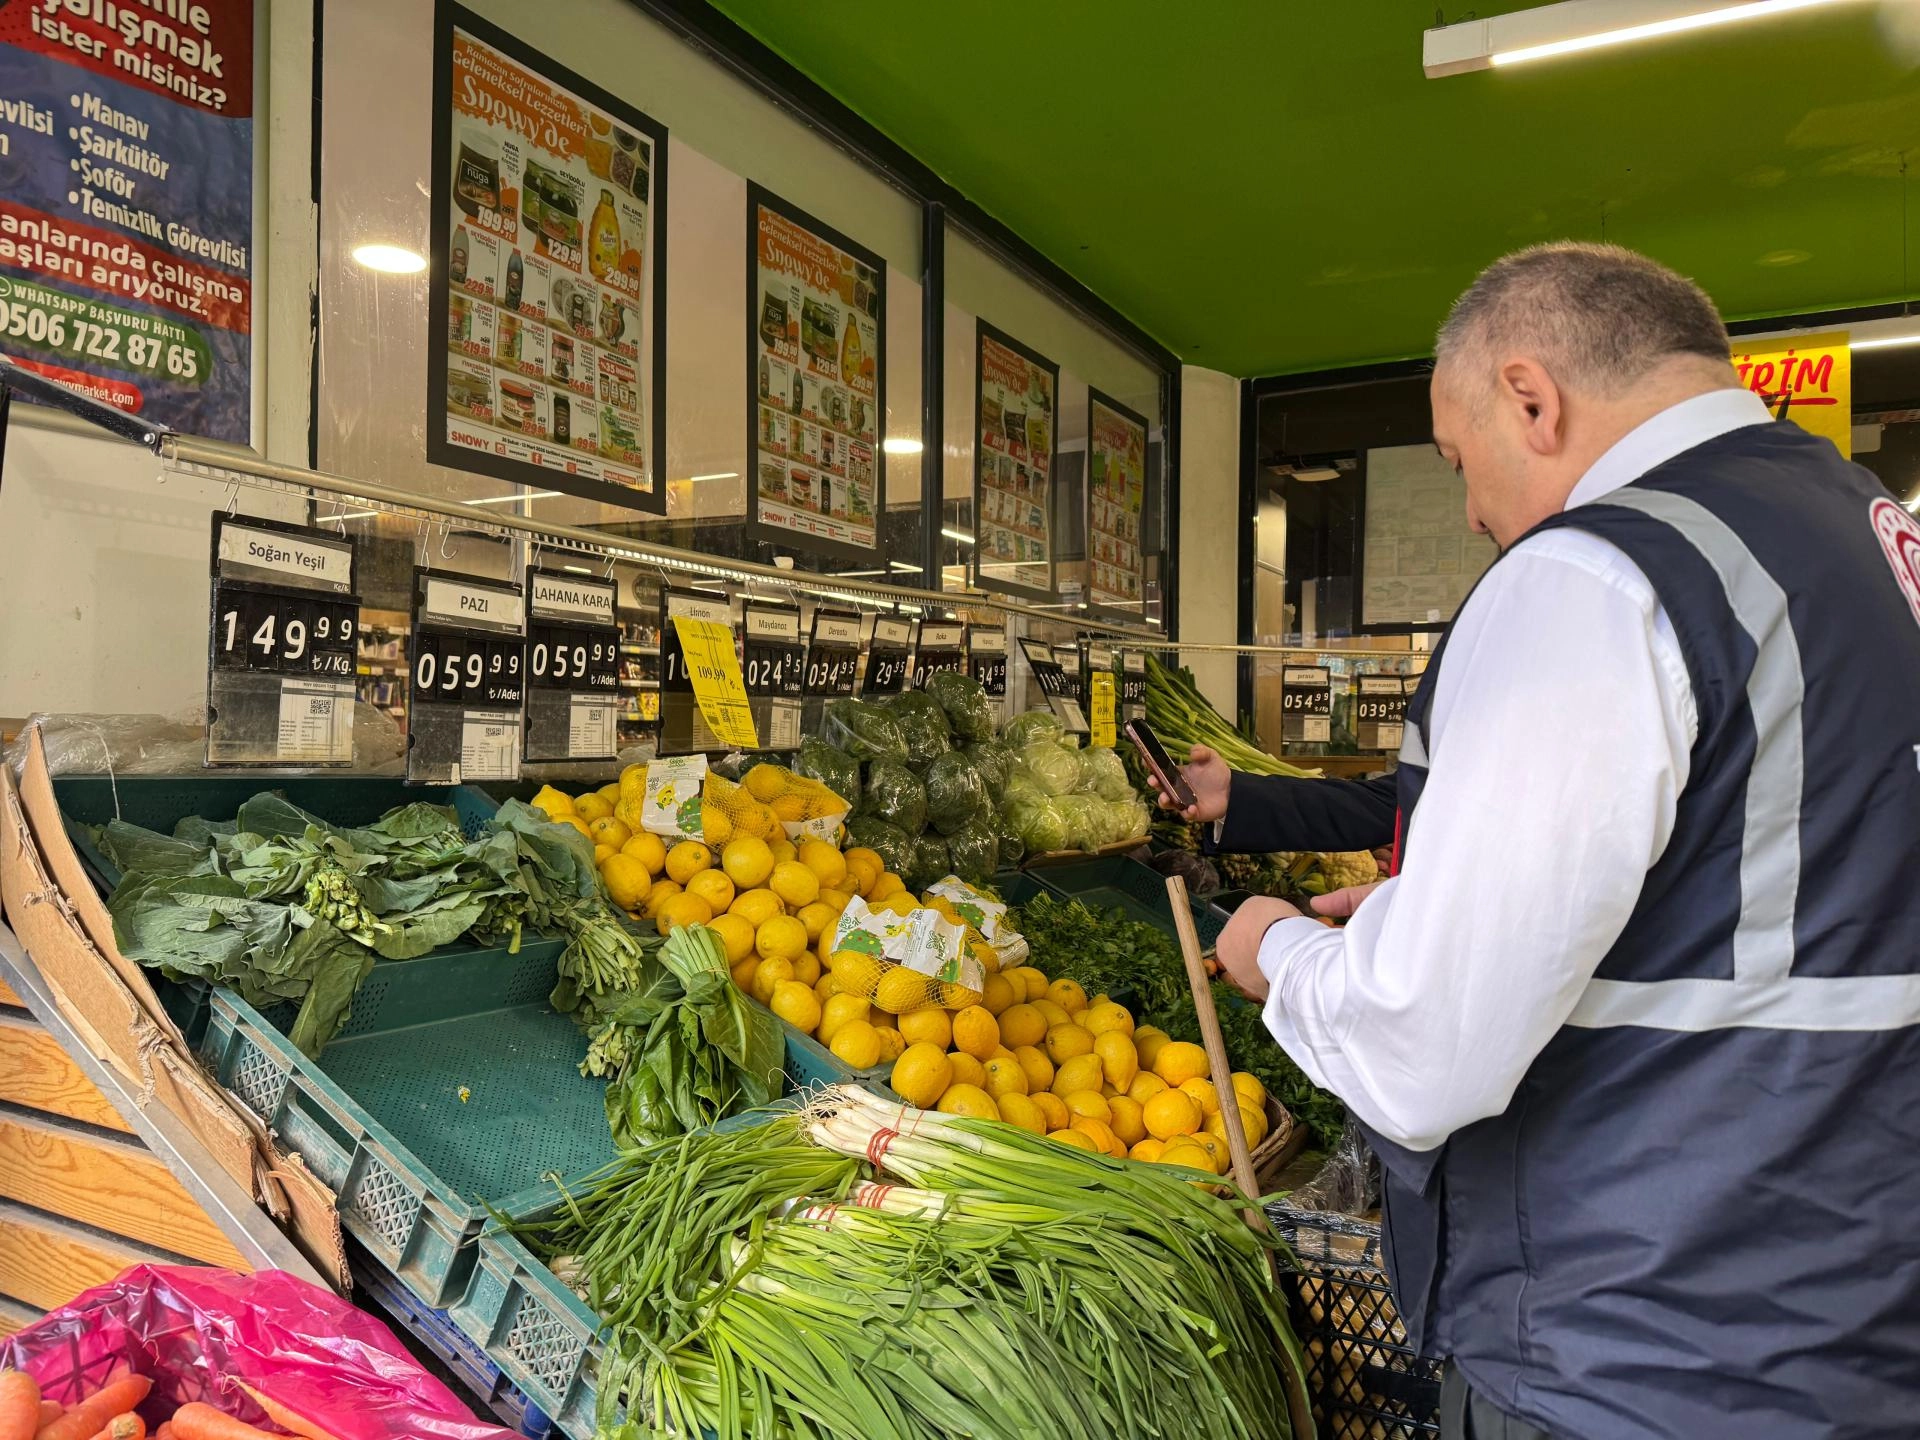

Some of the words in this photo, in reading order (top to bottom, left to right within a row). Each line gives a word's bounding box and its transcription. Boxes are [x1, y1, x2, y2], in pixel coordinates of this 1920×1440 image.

[31, 5, 107, 59] ister
[113, 48, 227, 110] misiniz?
[467, 45, 508, 78] Ramazan
[81, 92, 150, 141] Manav
[453, 50, 524, 102] Geleneksel
[526, 93, 587, 137] Lezzetleri
[463, 75, 570, 155] Snowy'de
[79, 126, 169, 181] Şarkütör
[79, 158, 136, 199] Şoför
[81, 188, 164, 240] Temizlik
[166, 222, 247, 270] Görevlisi
[760, 221, 803, 256] Geleneksel
[804, 247, 841, 275] Lezzetleri
[1, 214, 146, 270] anlarında
[152, 260, 243, 303] çalışma
[766, 239, 830, 289] Snowy'de
[13, 284, 86, 315] WHATSAPP
[89, 306, 149, 332] BAŞVURU
[153, 322, 186, 342] HATTI
[91, 264, 208, 316] arıyoruz.
[0, 302, 66, 347] 0506
[72, 319, 120, 361] 722
[127, 334, 162, 369] 87
[167, 344, 198, 379] 65
[452, 431, 489, 451] SNOWY
[764, 511, 787, 524] SNOWY
[248, 541, 290, 563] Soğan
[295, 551, 325, 571] Yeşil
[461, 596, 488, 613] PAZI
[535, 586, 580, 606] LAHANA
[582, 588, 611, 609] KARA
[759, 619, 786, 632] Maydanoz
[698, 665, 726, 682] 109.99
